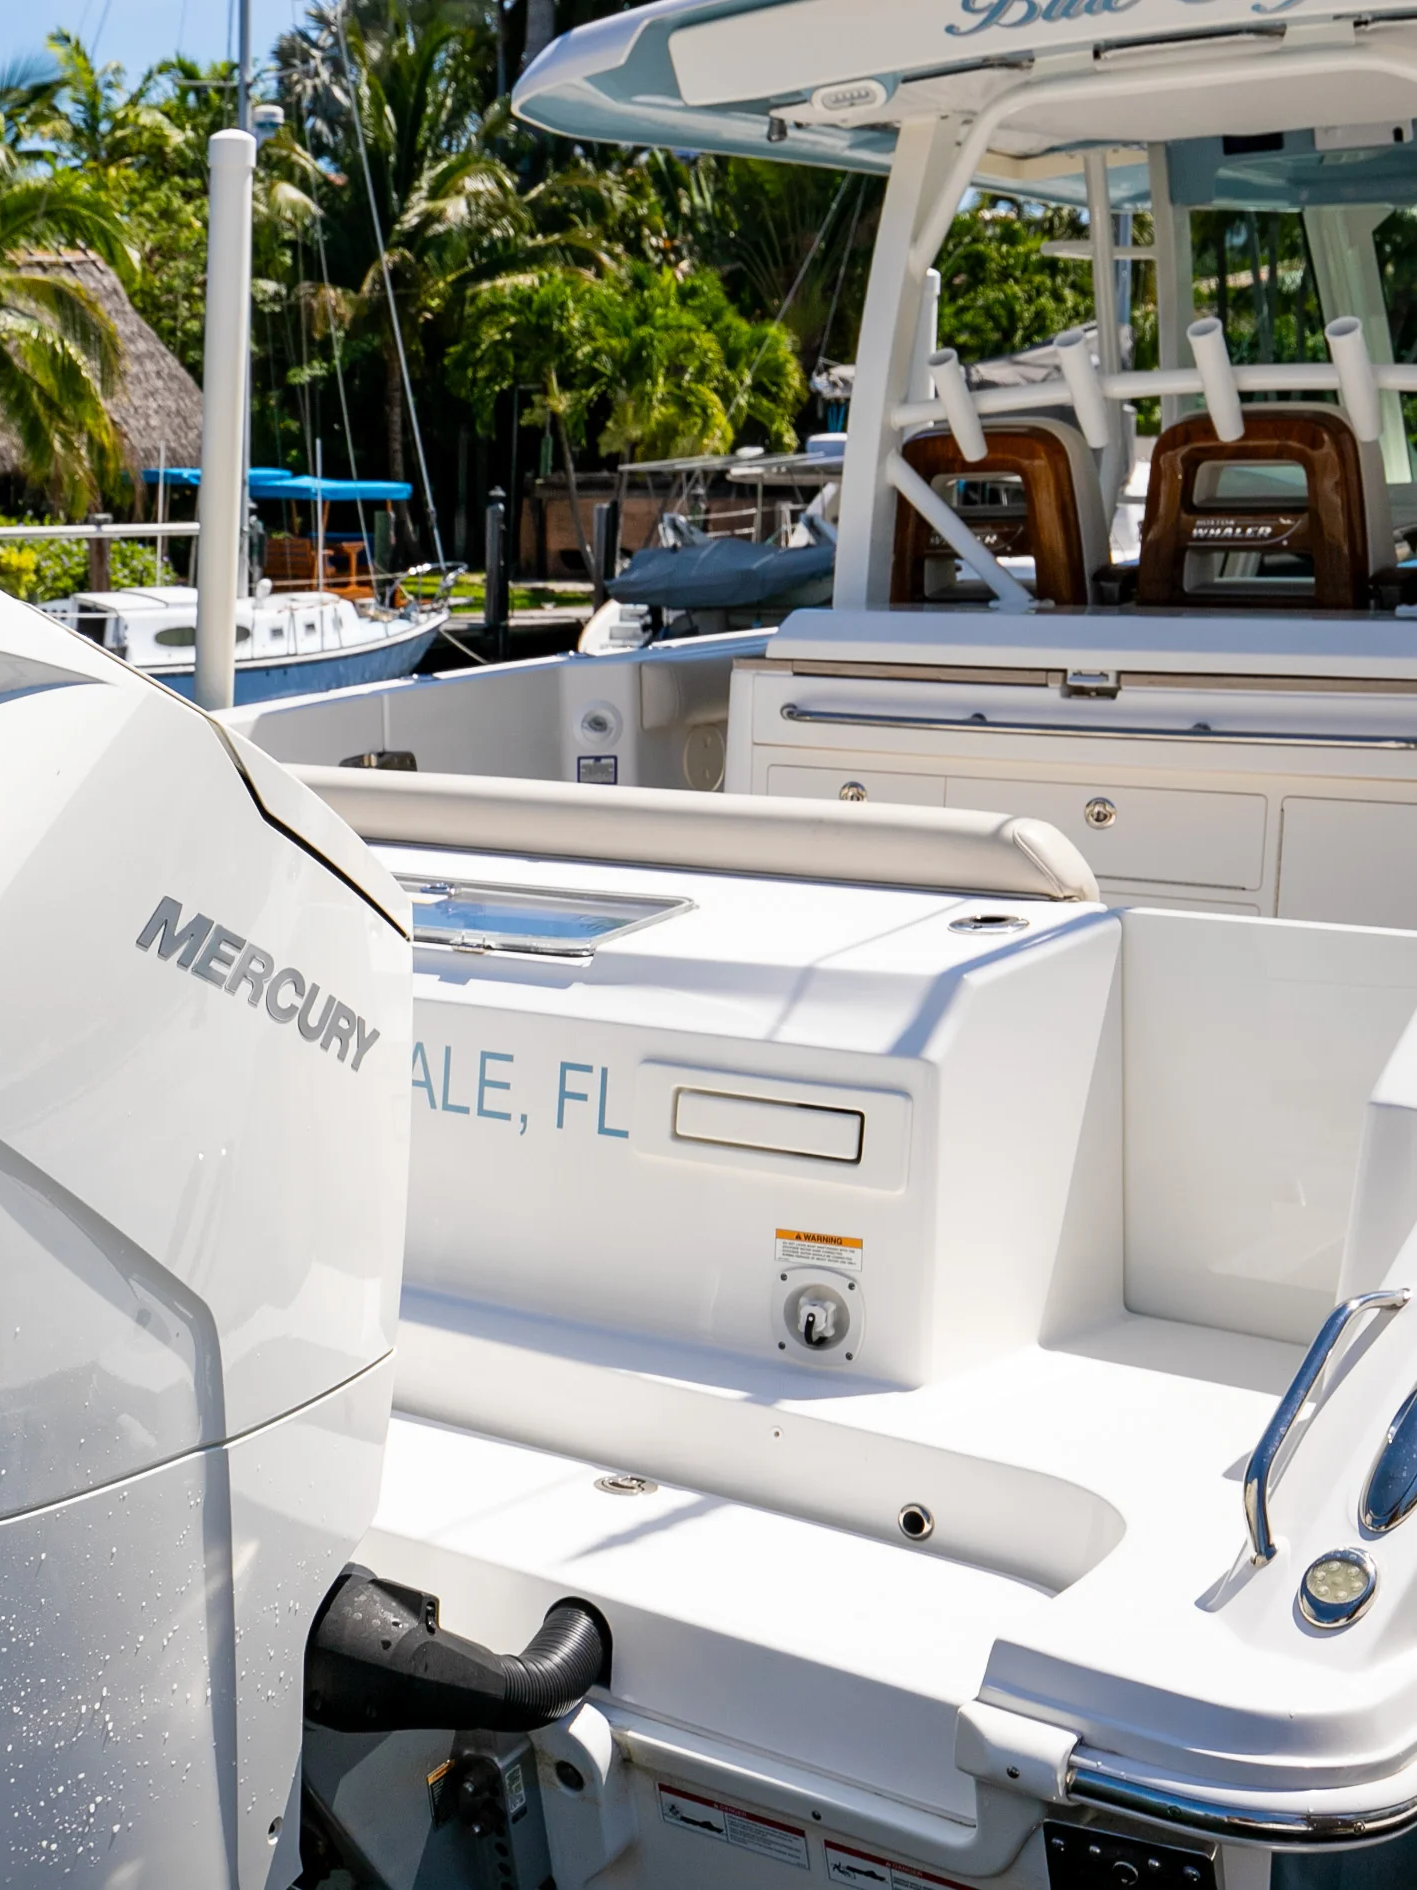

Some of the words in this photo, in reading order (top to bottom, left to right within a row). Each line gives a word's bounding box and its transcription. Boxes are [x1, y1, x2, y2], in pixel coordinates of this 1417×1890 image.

[1192, 526, 1273, 539] WHALER
[135, 895, 381, 1072] MERCURY
[556, 1061, 629, 1139] FL
[803, 1233, 843, 1246] WARNING
